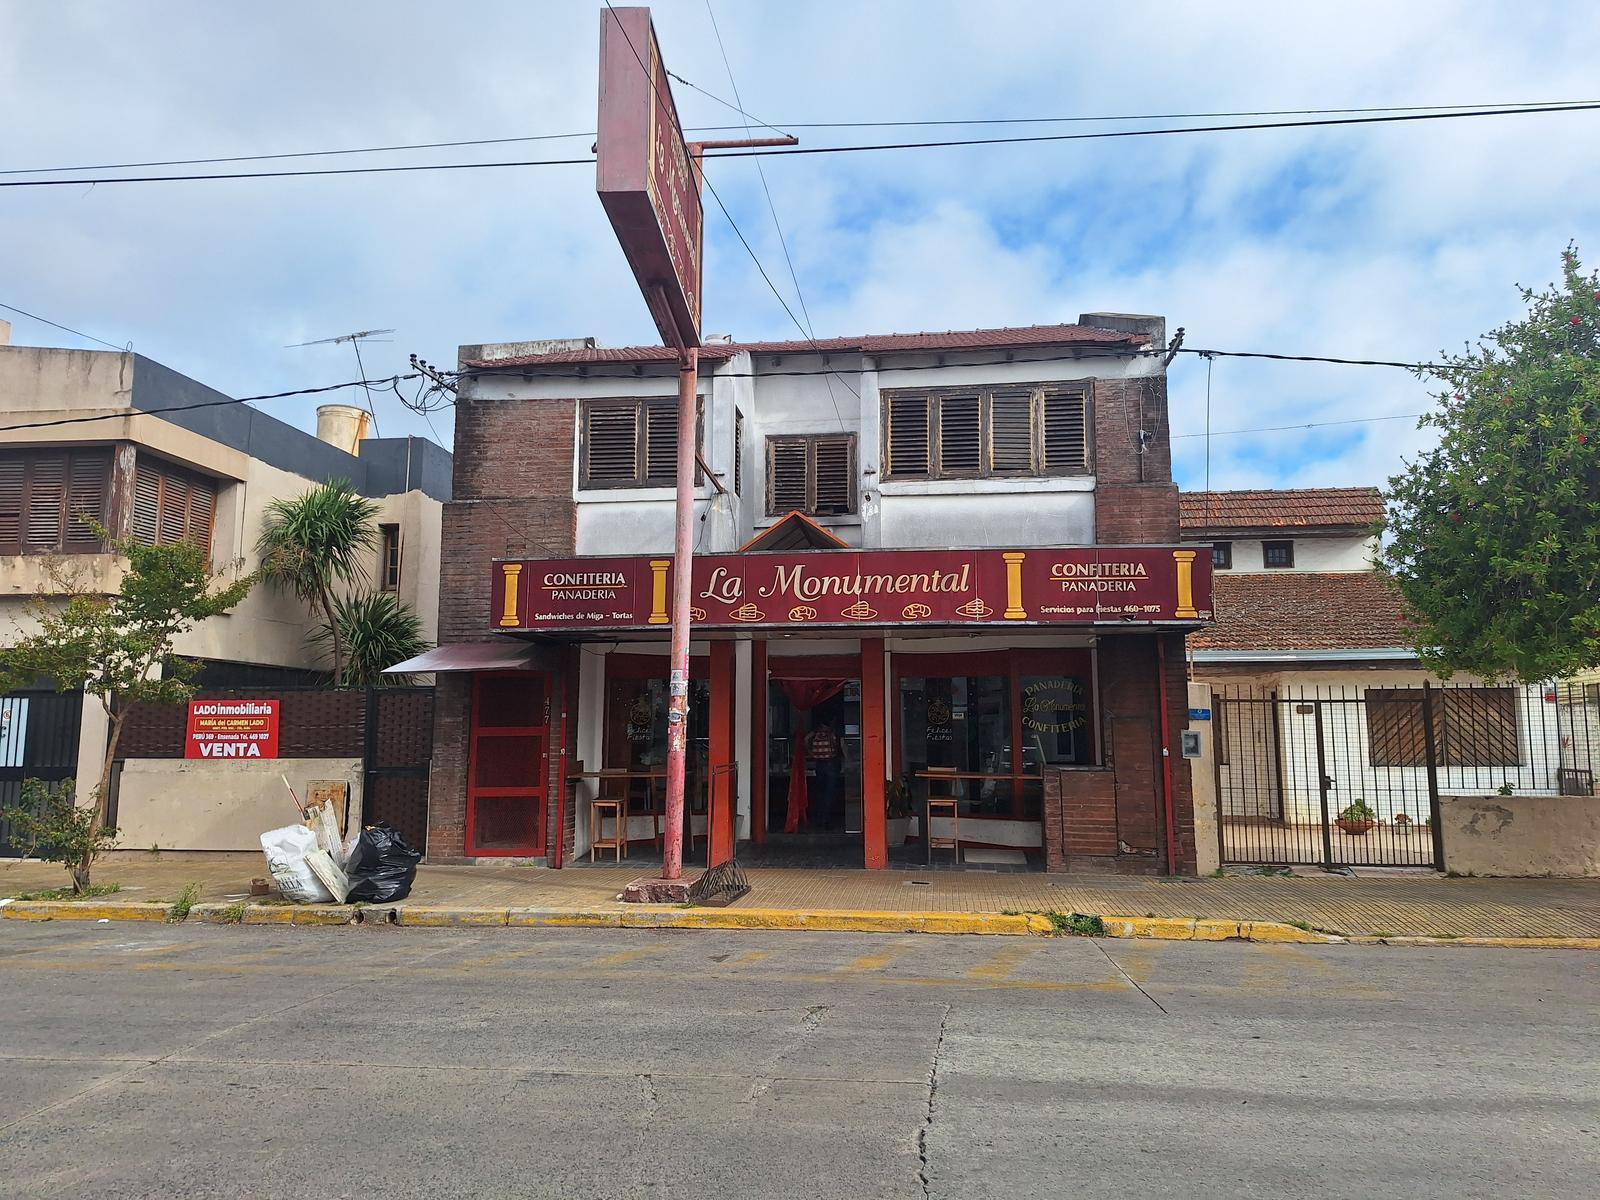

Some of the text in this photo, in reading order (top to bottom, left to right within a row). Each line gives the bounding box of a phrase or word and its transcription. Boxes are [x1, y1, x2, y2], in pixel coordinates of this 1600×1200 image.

[1051, 563, 1147, 576] CONFITERIA
[543, 572, 626, 586] CONFITERIA
[700, 564, 970, 604] La Monumental
[1062, 581, 1137, 592] PANADERIA
[551, 589, 616, 600] PANADERIA
[534, 612, 574, 621] Sandwiches
[575, 611, 585, 620] de
[586, 612, 604, 621] Miga
[612, 611, 633, 619] Tortas
[1040, 605, 1075, 613] Servicios
[1076, 606, 1094, 615] para
[1123, 604, 1161, 613] 460-1075
[1024, 680, 1084, 697] PANADERIA
[1022, 716, 1088, 733] CONFITERIA
[199, 742, 261, 757] VENTA
